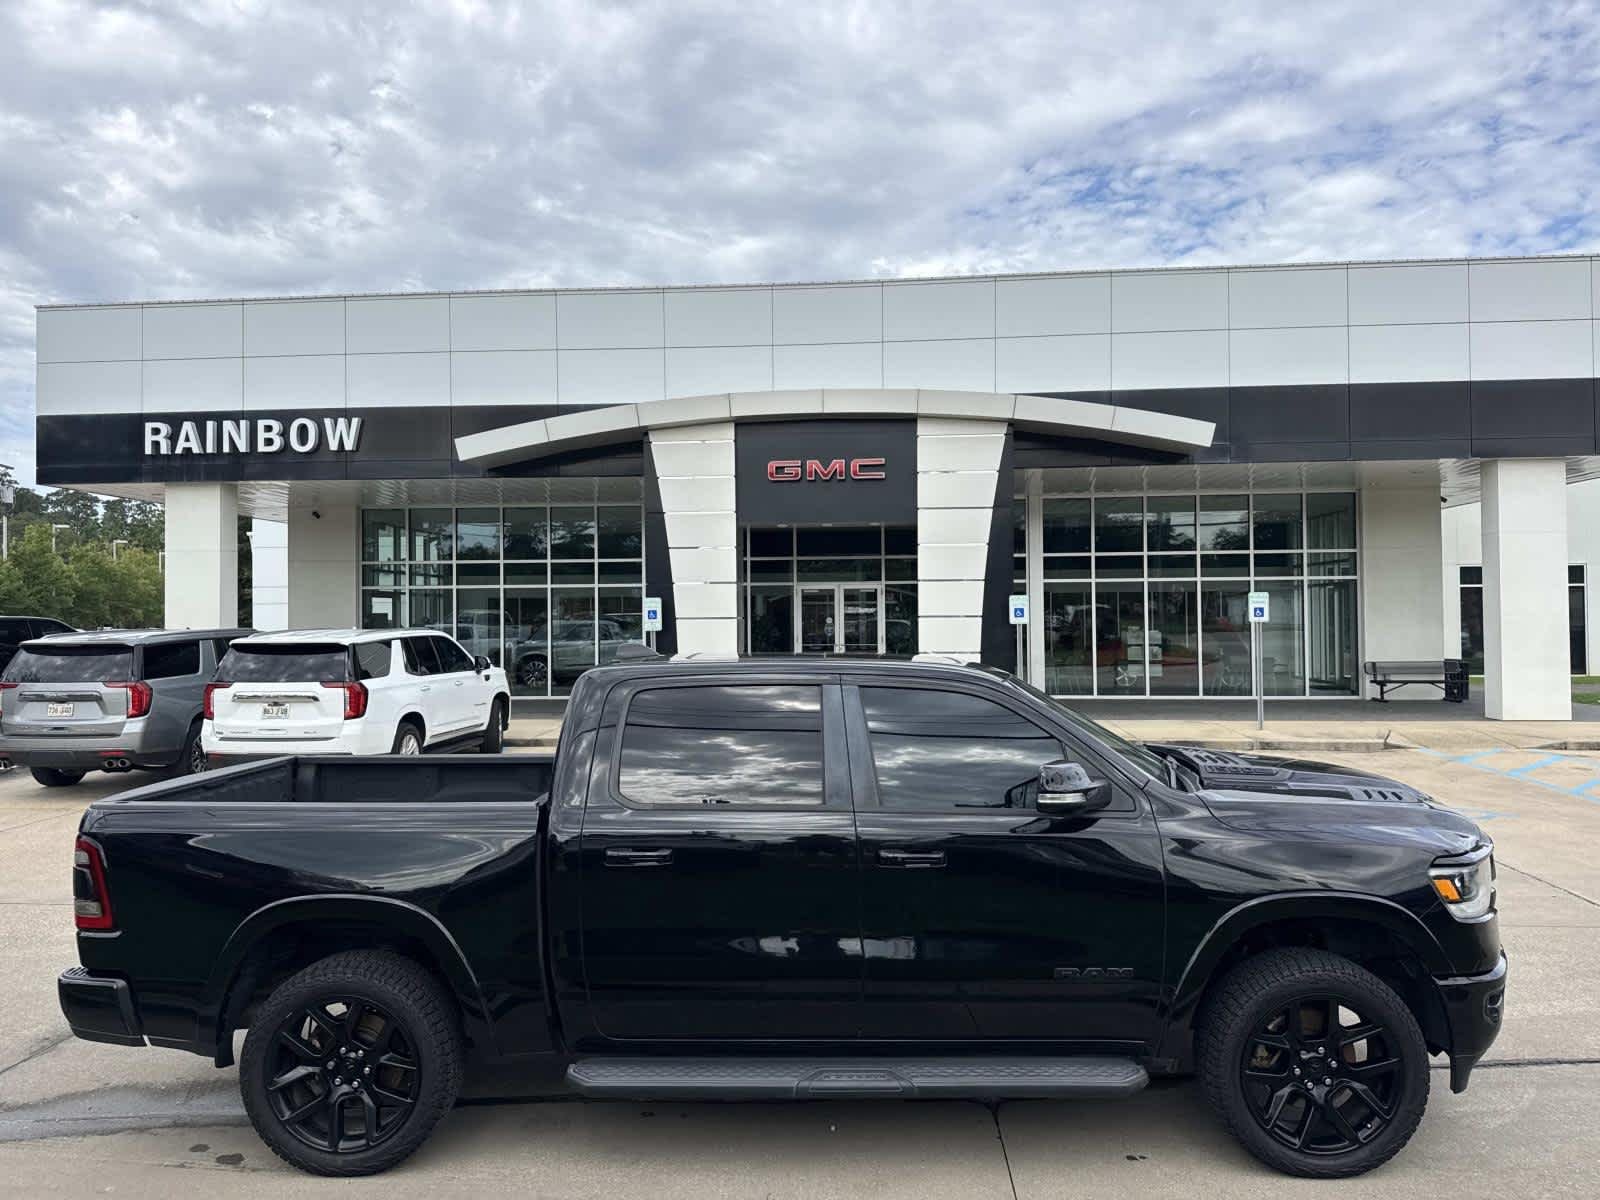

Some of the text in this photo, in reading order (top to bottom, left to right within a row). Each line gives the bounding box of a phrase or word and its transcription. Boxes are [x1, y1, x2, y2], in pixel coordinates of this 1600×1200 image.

[144, 417, 361, 455] RAINBOW
[767, 457, 886, 481] GMC
[1055, 967, 1135, 978] RAM
